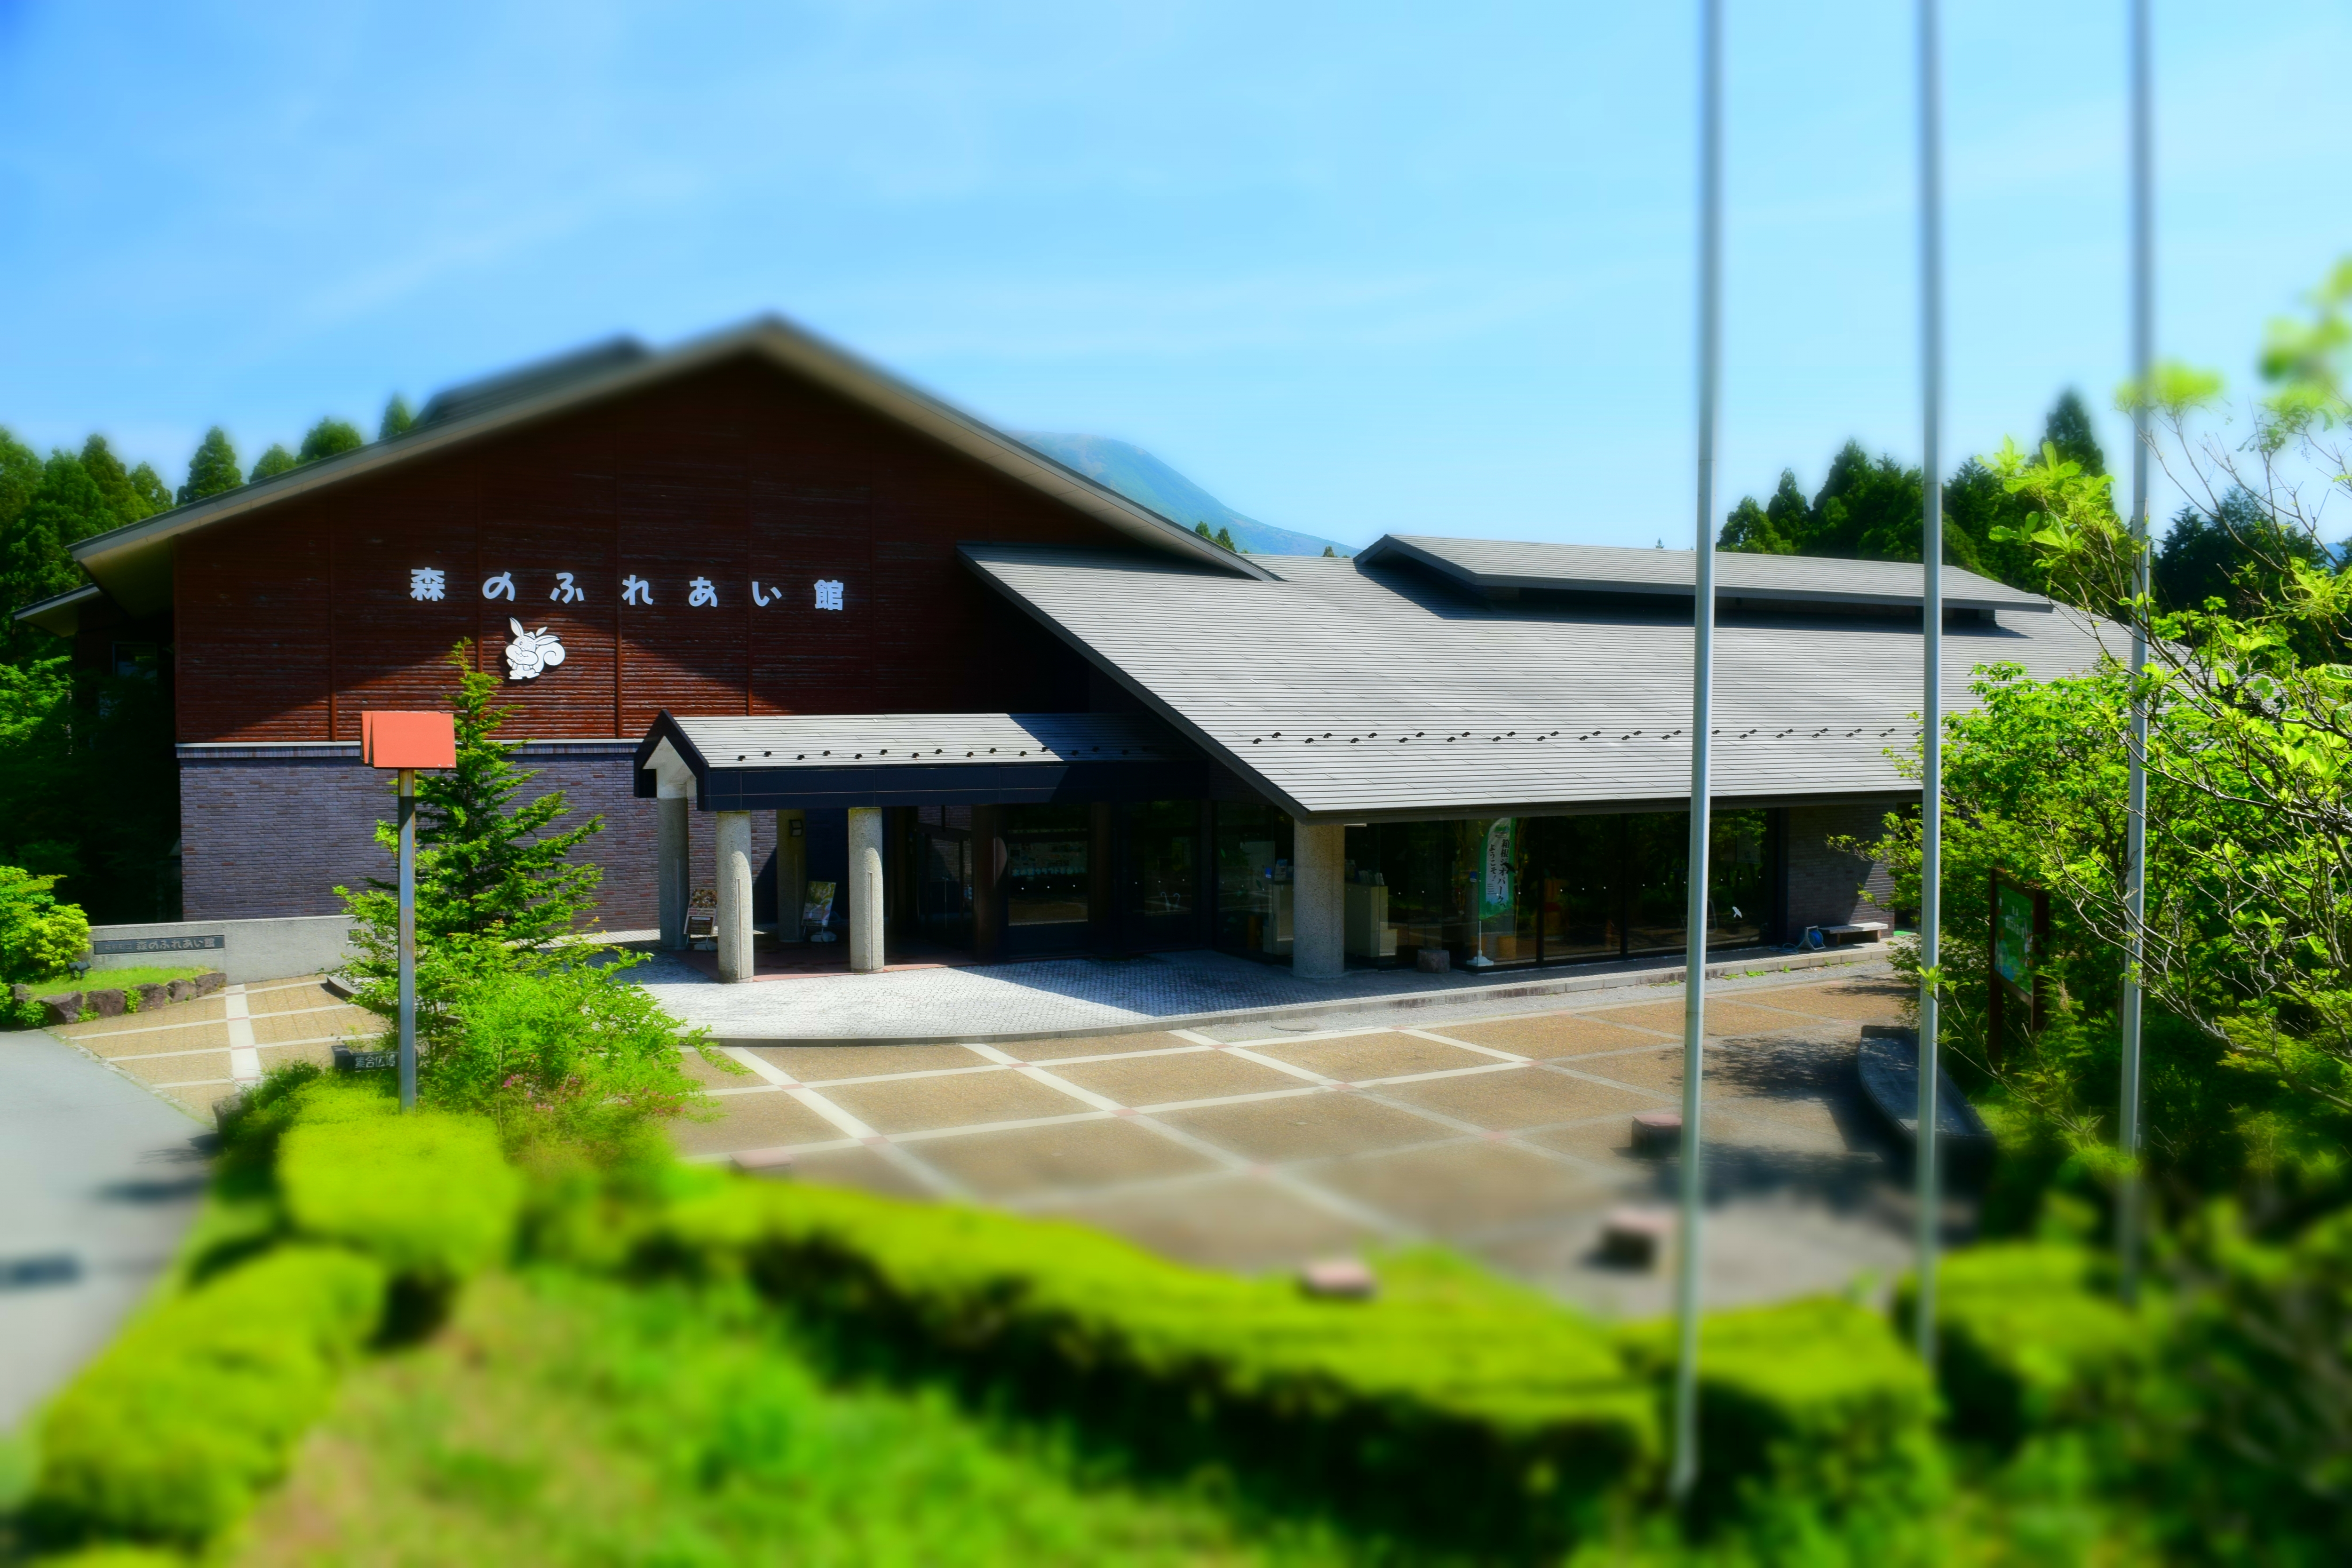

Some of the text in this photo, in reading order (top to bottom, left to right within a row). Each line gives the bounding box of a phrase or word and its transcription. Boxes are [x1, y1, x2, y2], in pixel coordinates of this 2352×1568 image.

[410, 567, 844, 611] 森のふれあい館
[1497, 839, 1510, 908] 箱根ジオパークへ
[136, 938, 215, 951] 森のふれあい館
[355, 1054, 396, 1068] 集合広場
